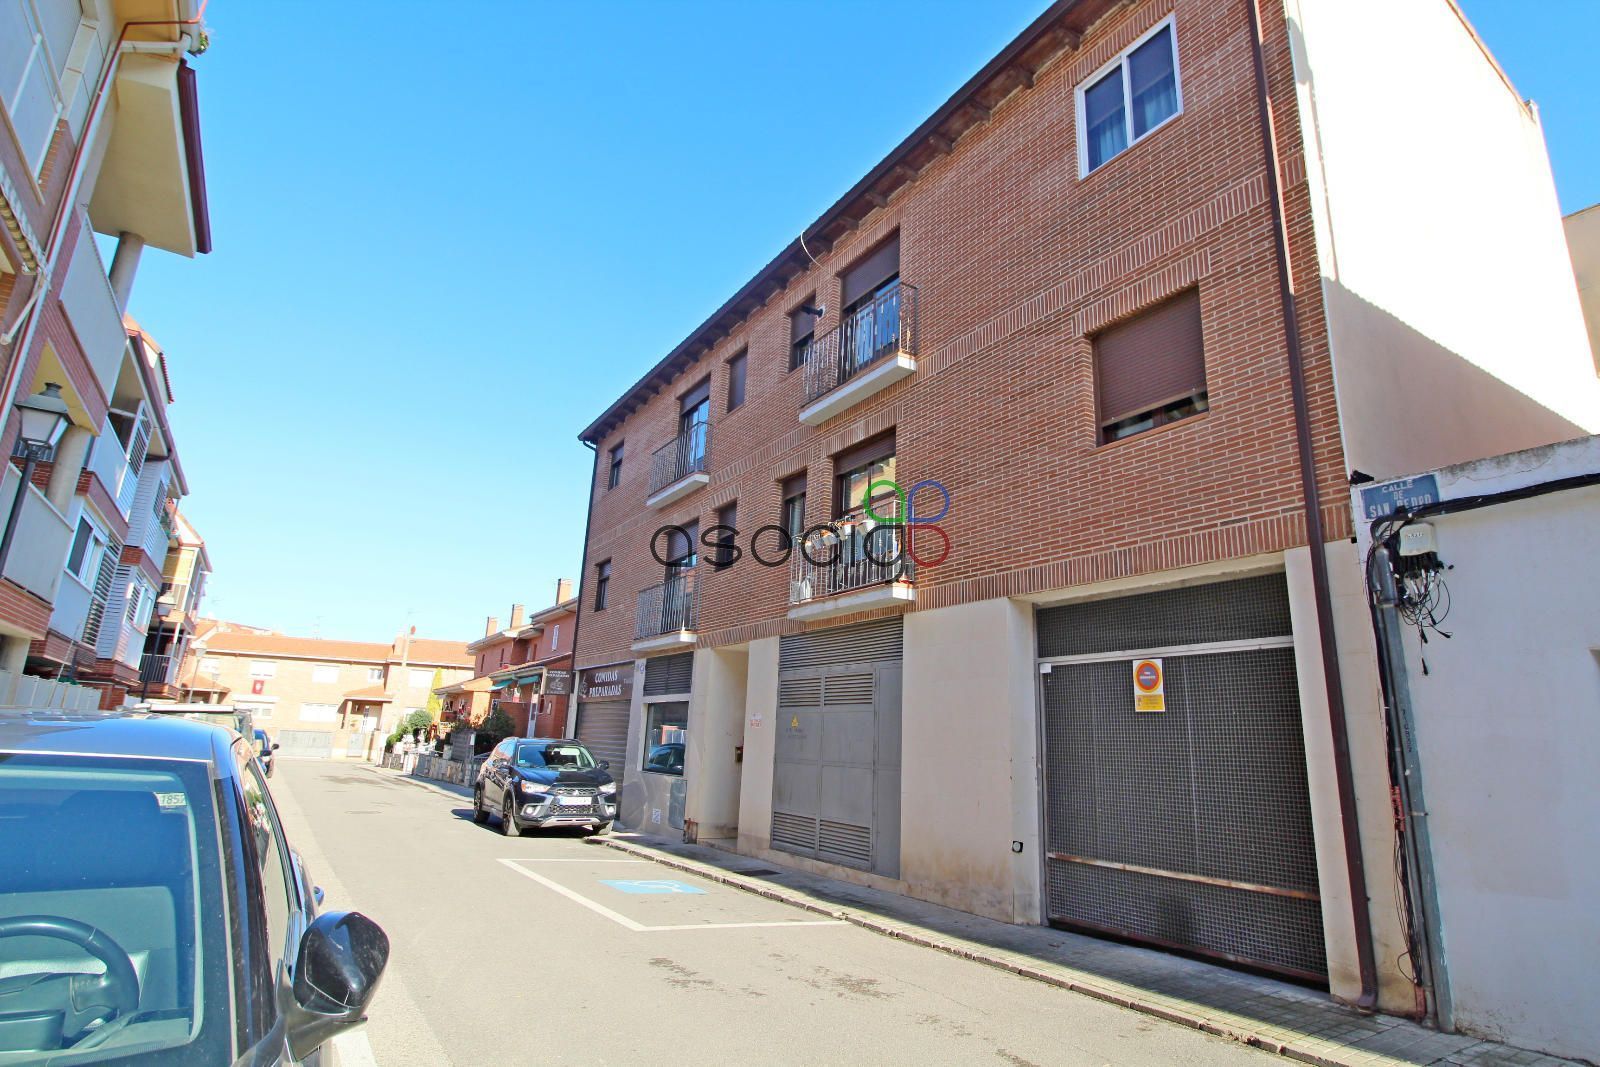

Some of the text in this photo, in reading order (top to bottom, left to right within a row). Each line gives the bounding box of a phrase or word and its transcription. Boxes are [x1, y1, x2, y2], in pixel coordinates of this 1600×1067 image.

[1382, 480, 1414, 493] CALLE
[1393, 491, 1404, 500] DE
[1369, 502, 1390, 517] SAN
[595, 671, 618, 683] COMIDAS
